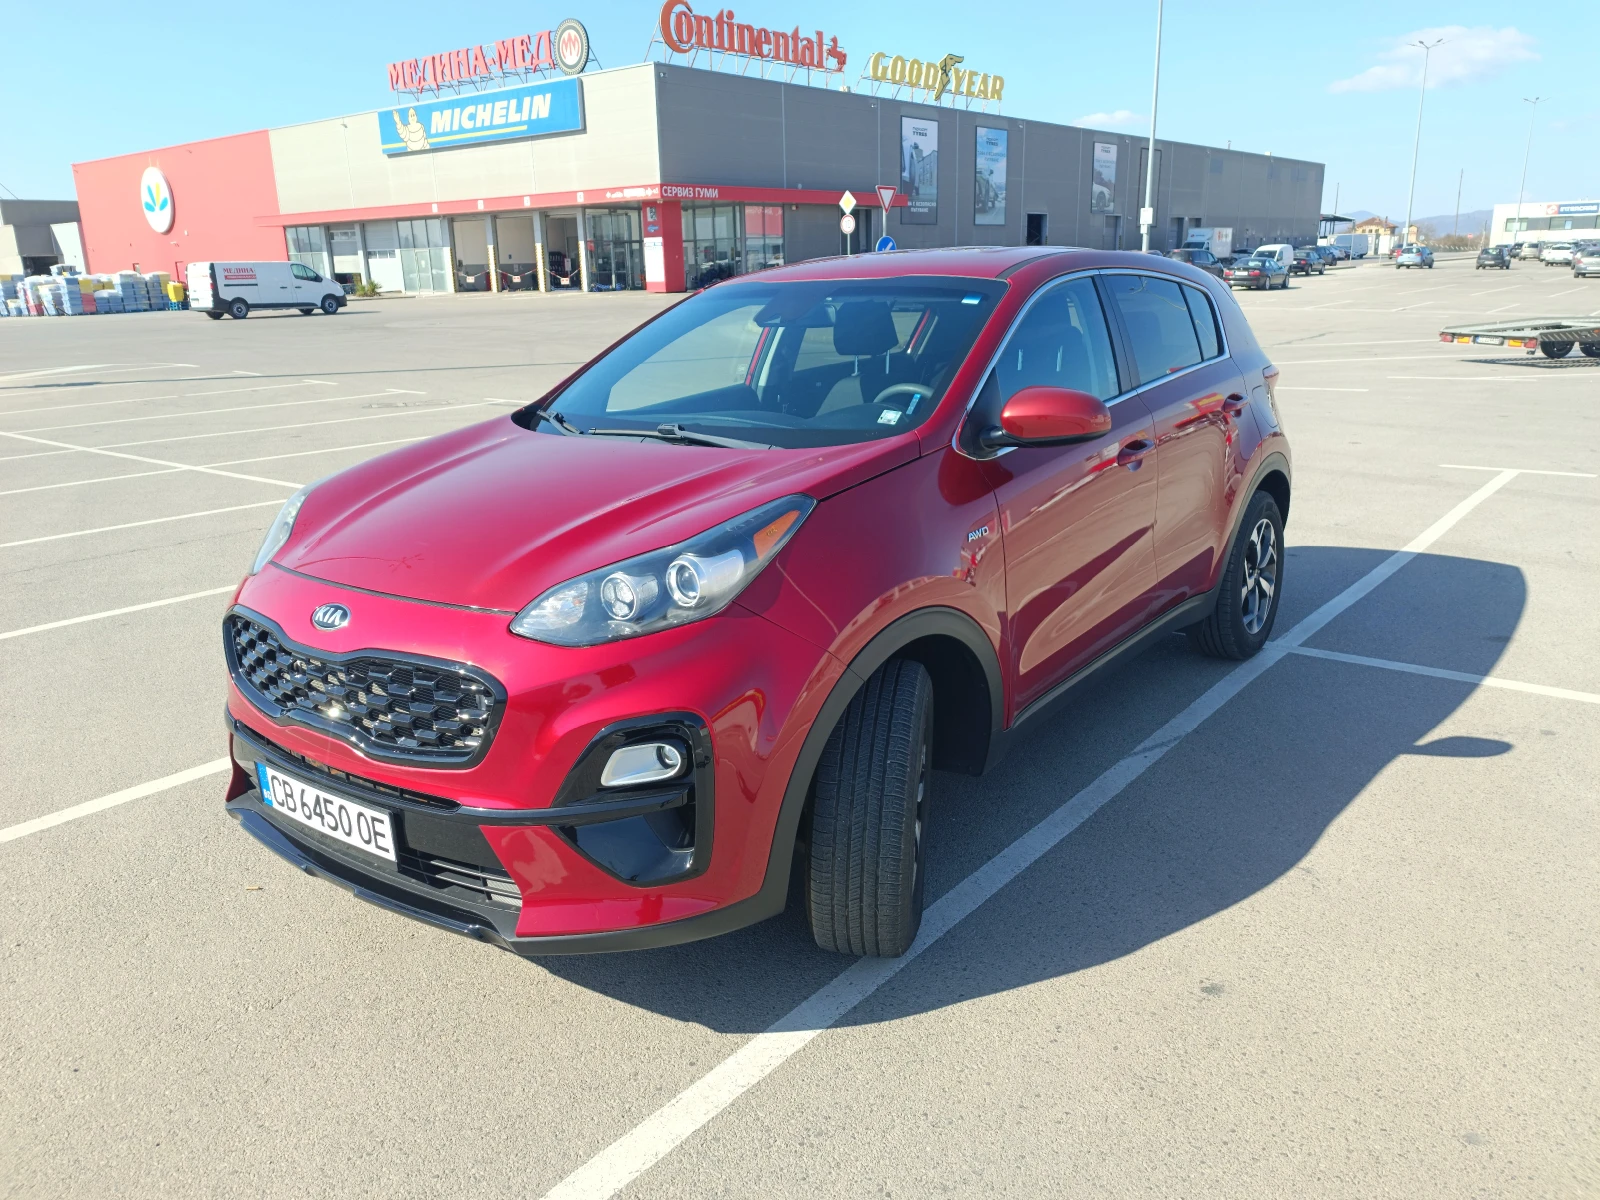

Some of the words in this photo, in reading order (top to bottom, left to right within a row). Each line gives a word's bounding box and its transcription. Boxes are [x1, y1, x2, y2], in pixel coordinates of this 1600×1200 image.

[660, 0, 824, 69] Continental
[387, 30, 556, 94] МЕДИНА-МЕД
[430, 93, 552, 134] MICHELIN
[662, 186, 694, 198] СЕРВИЗ
[695, 187, 719, 199] ГУМИ
[968, 525, 989, 543] AWD
[315, 606, 344, 626] KIA
[300, 788, 352, 838] 6450
